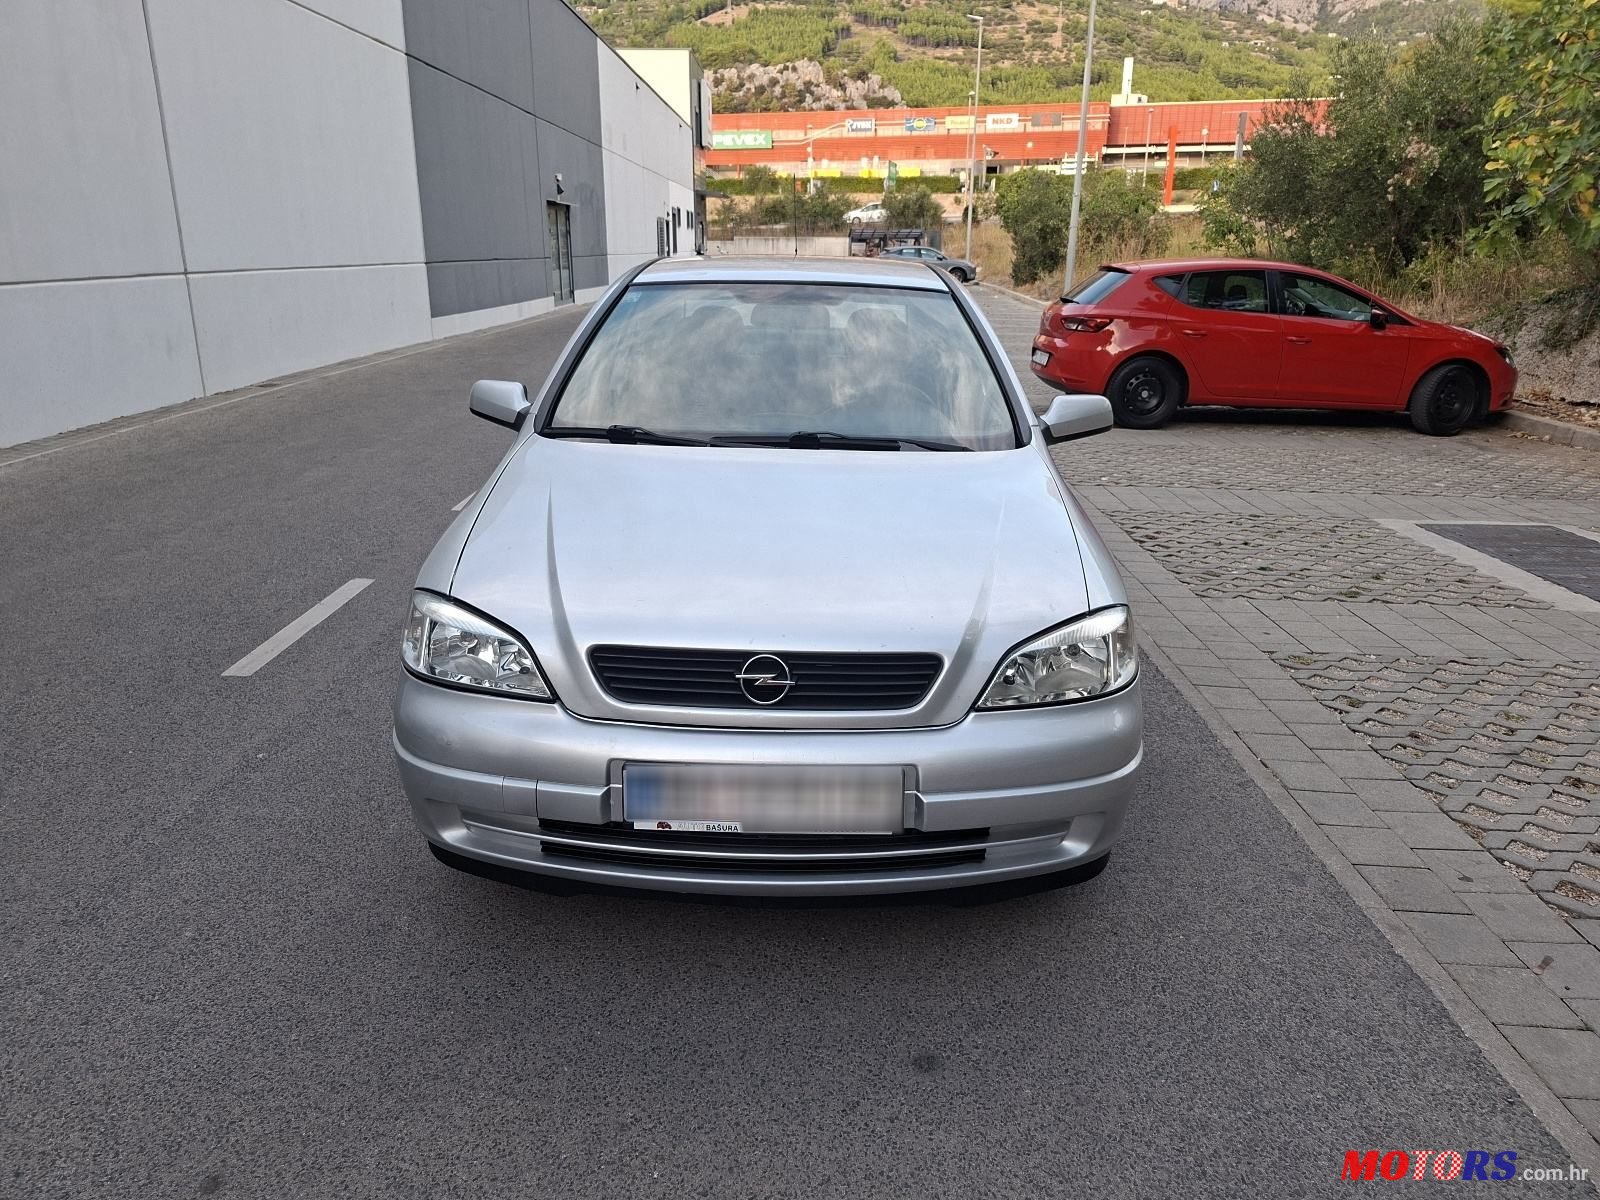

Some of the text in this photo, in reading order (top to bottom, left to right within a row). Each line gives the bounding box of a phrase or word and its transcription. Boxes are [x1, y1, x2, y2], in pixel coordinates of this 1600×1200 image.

[992, 117, 1013, 125] NKD
[712, 133, 766, 146] PEVEX
[706, 824, 739, 832] BAŠURA
